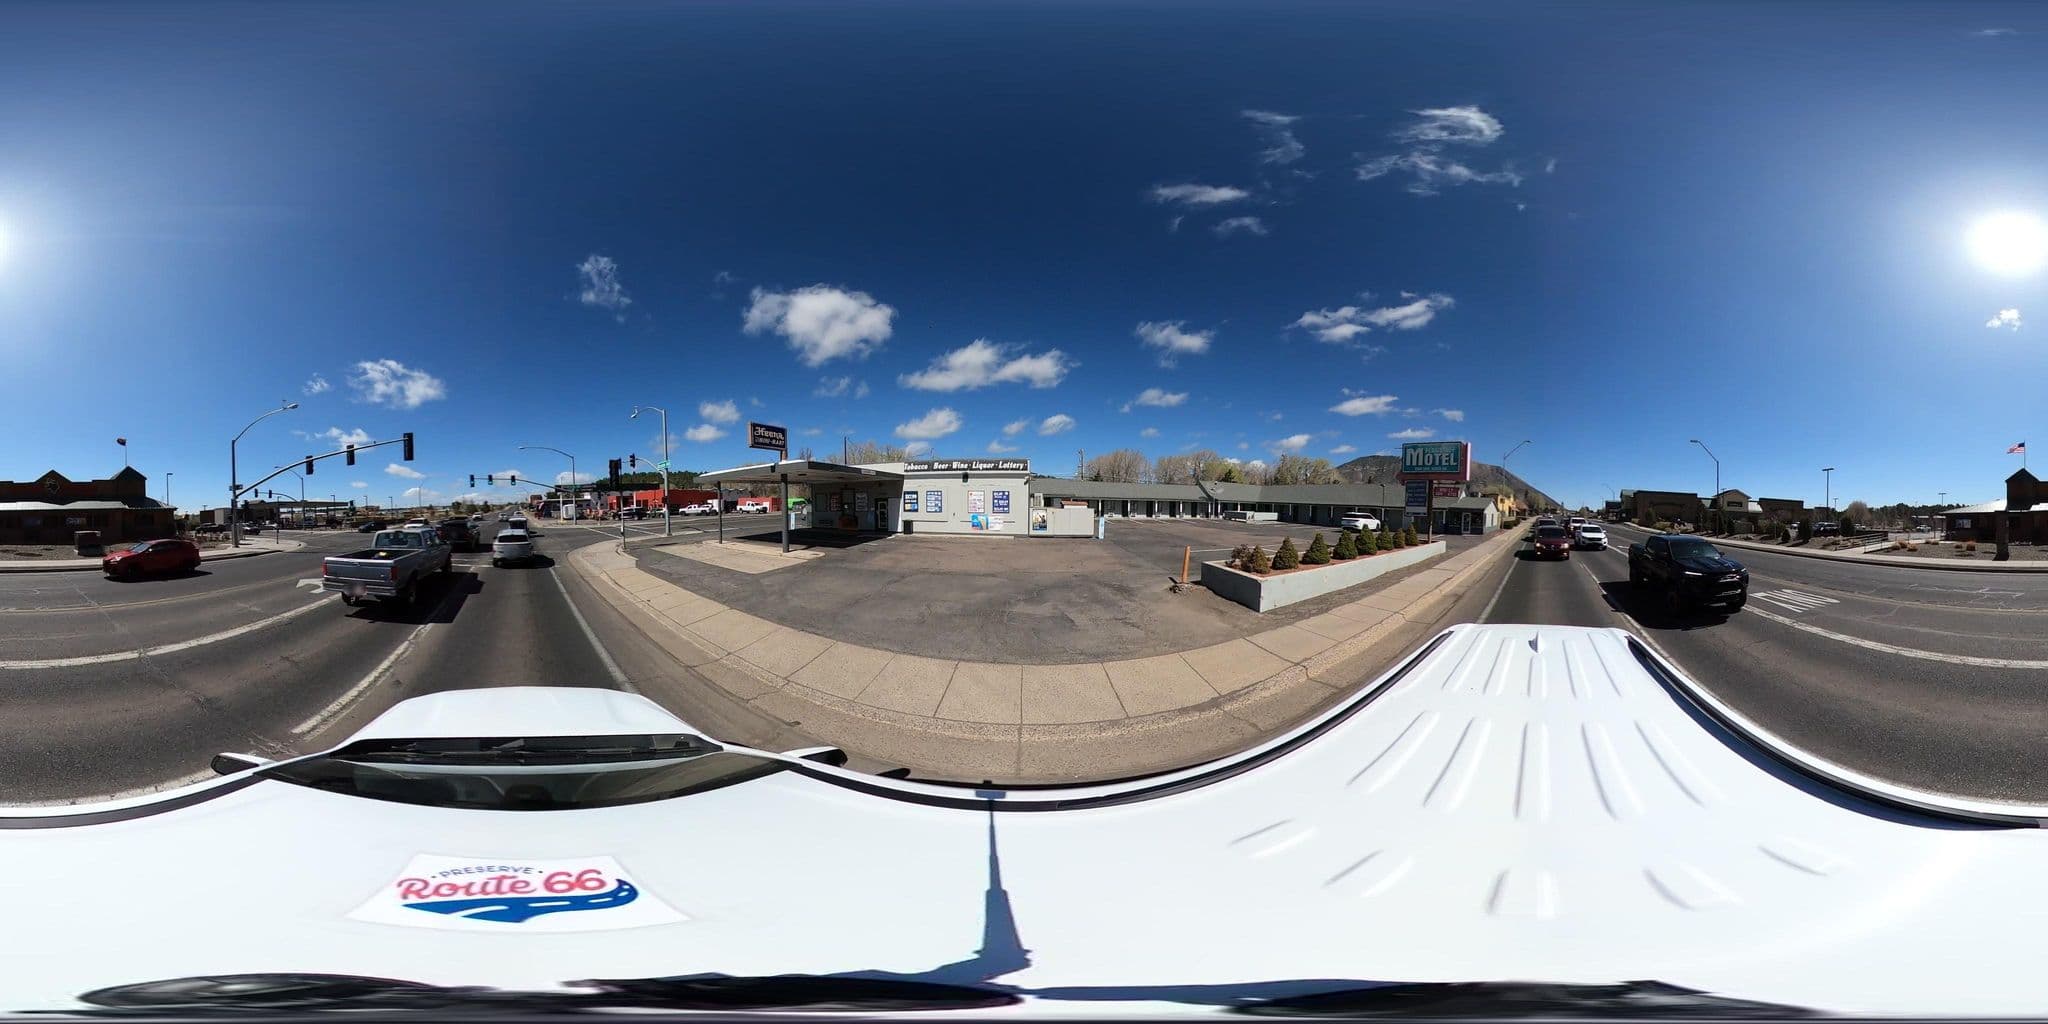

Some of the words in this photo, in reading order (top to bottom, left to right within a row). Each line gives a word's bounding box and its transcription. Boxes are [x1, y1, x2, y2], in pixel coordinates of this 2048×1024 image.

[1406, 448, 1457, 466] MOTEL
[904, 463, 929, 471] Tobacco
[933, 462, 948, 470] Beer
[952, 462, 968, 470] Wine
[972, 461, 994, 470] Liquor
[998, 460, 1024, 470] Lottery
[439, 865, 534, 879] PRESERVE
[397, 874, 537, 900] Route
[543, 868, 607, 894] 66
